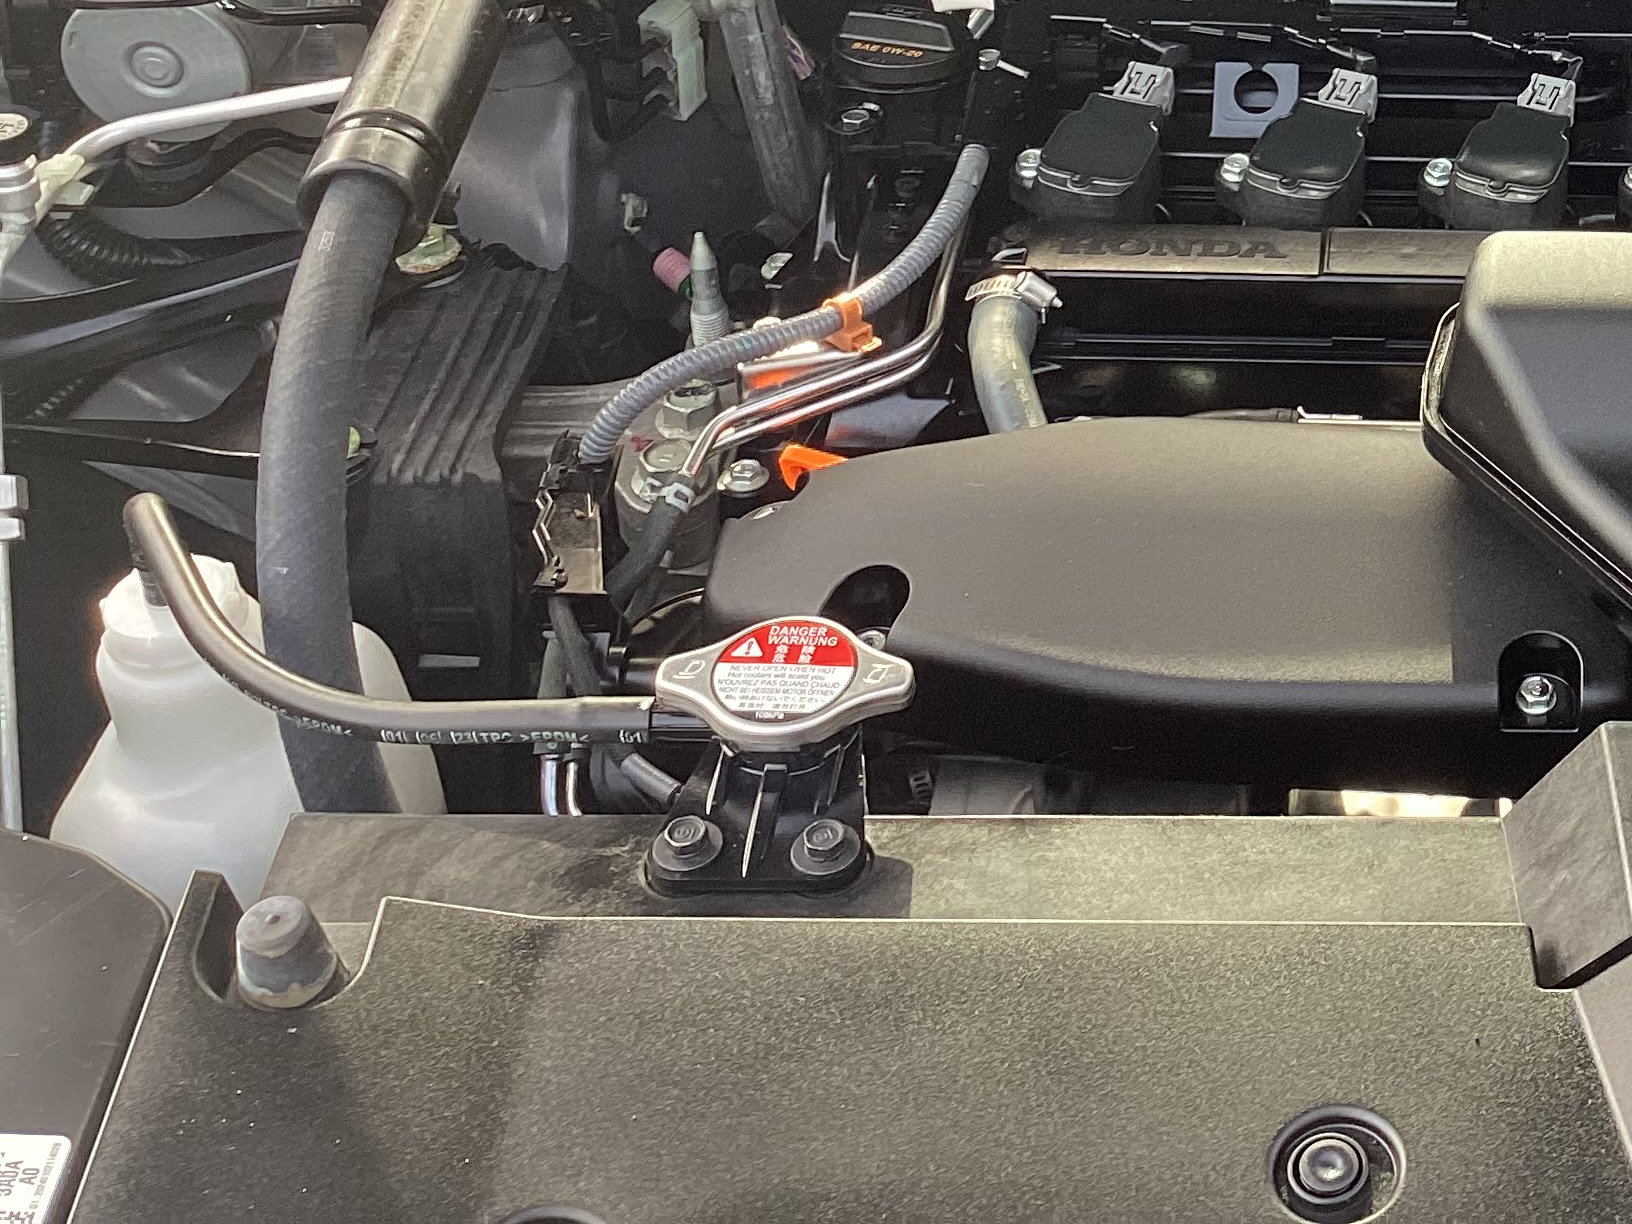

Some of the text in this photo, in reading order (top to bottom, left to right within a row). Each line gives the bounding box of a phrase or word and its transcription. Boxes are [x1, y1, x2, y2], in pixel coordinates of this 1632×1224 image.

[851, 42, 924, 58] SAE 0W-20
[1051, 237, 1287, 258] HONDA
[769, 625, 828, 636] DANGER
[767, 635, 839, 647] WARNUNG
